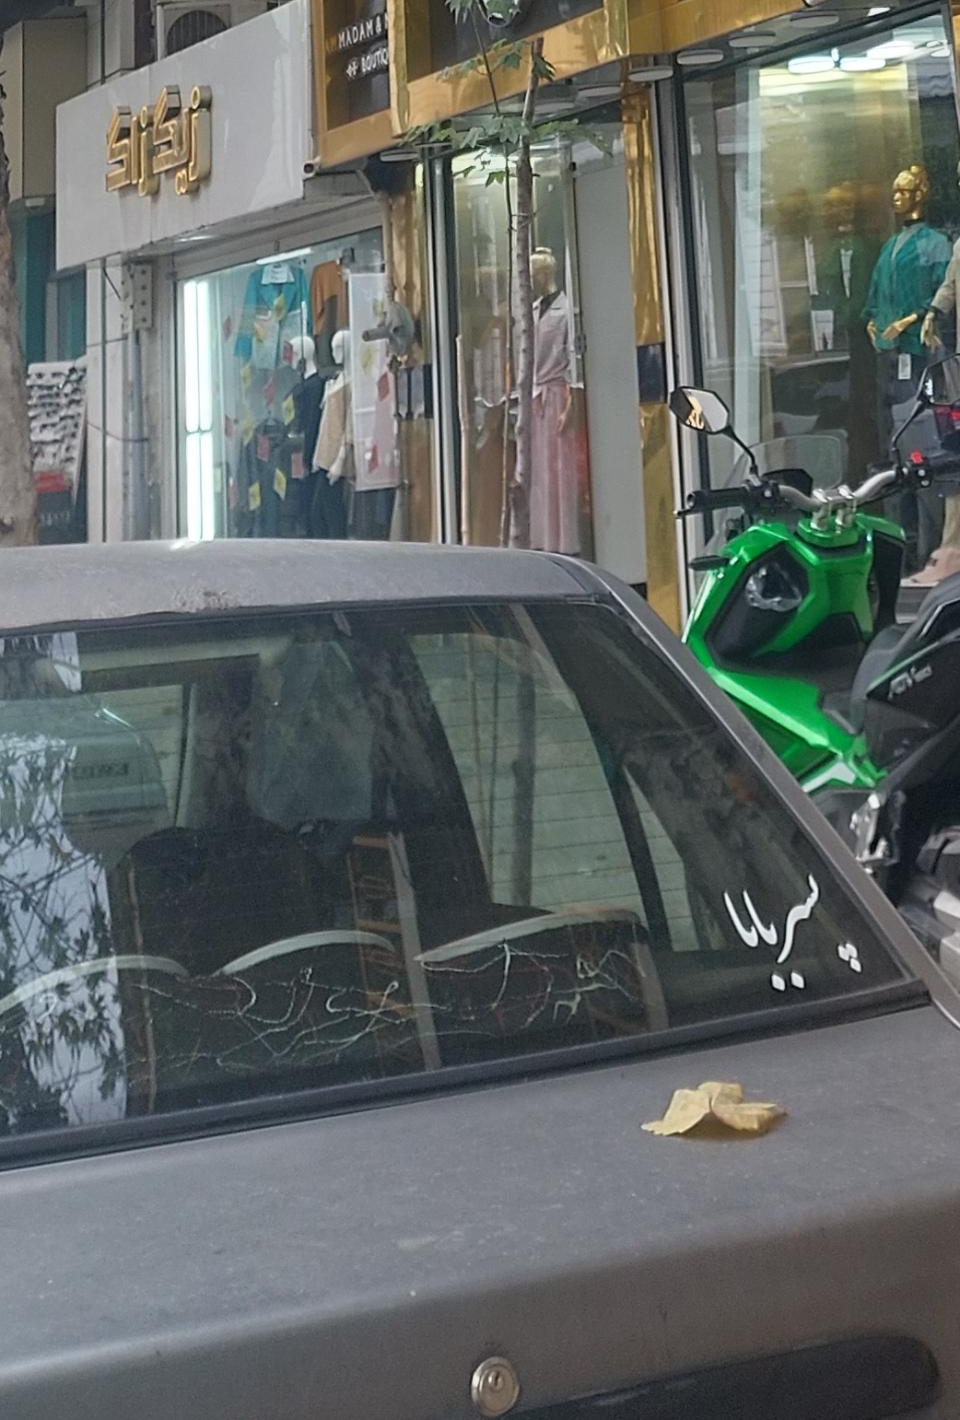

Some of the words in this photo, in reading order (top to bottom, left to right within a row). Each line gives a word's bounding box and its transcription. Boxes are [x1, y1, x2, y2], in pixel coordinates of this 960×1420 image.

[338, 18, 374, 49] MADAM
[375, 15, 382, 35] &
[361, 48, 389, 73] BOUTIQ
